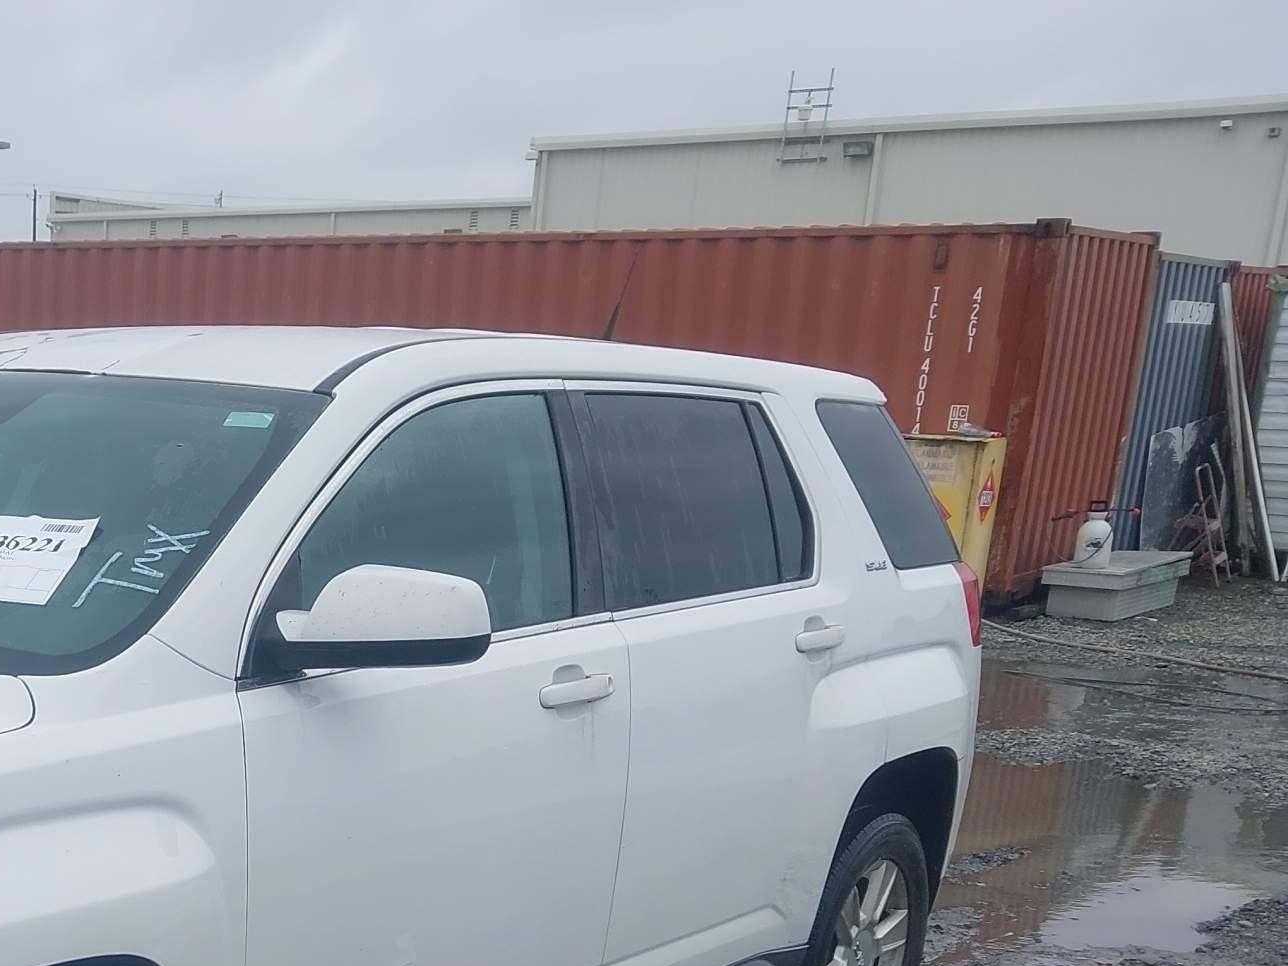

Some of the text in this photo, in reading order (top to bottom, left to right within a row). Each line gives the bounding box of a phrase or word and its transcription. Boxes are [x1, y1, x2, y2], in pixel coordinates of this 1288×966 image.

[911, 286, 941, 435] TCLU 40014
[967, 286, 983, 353] 42G1
